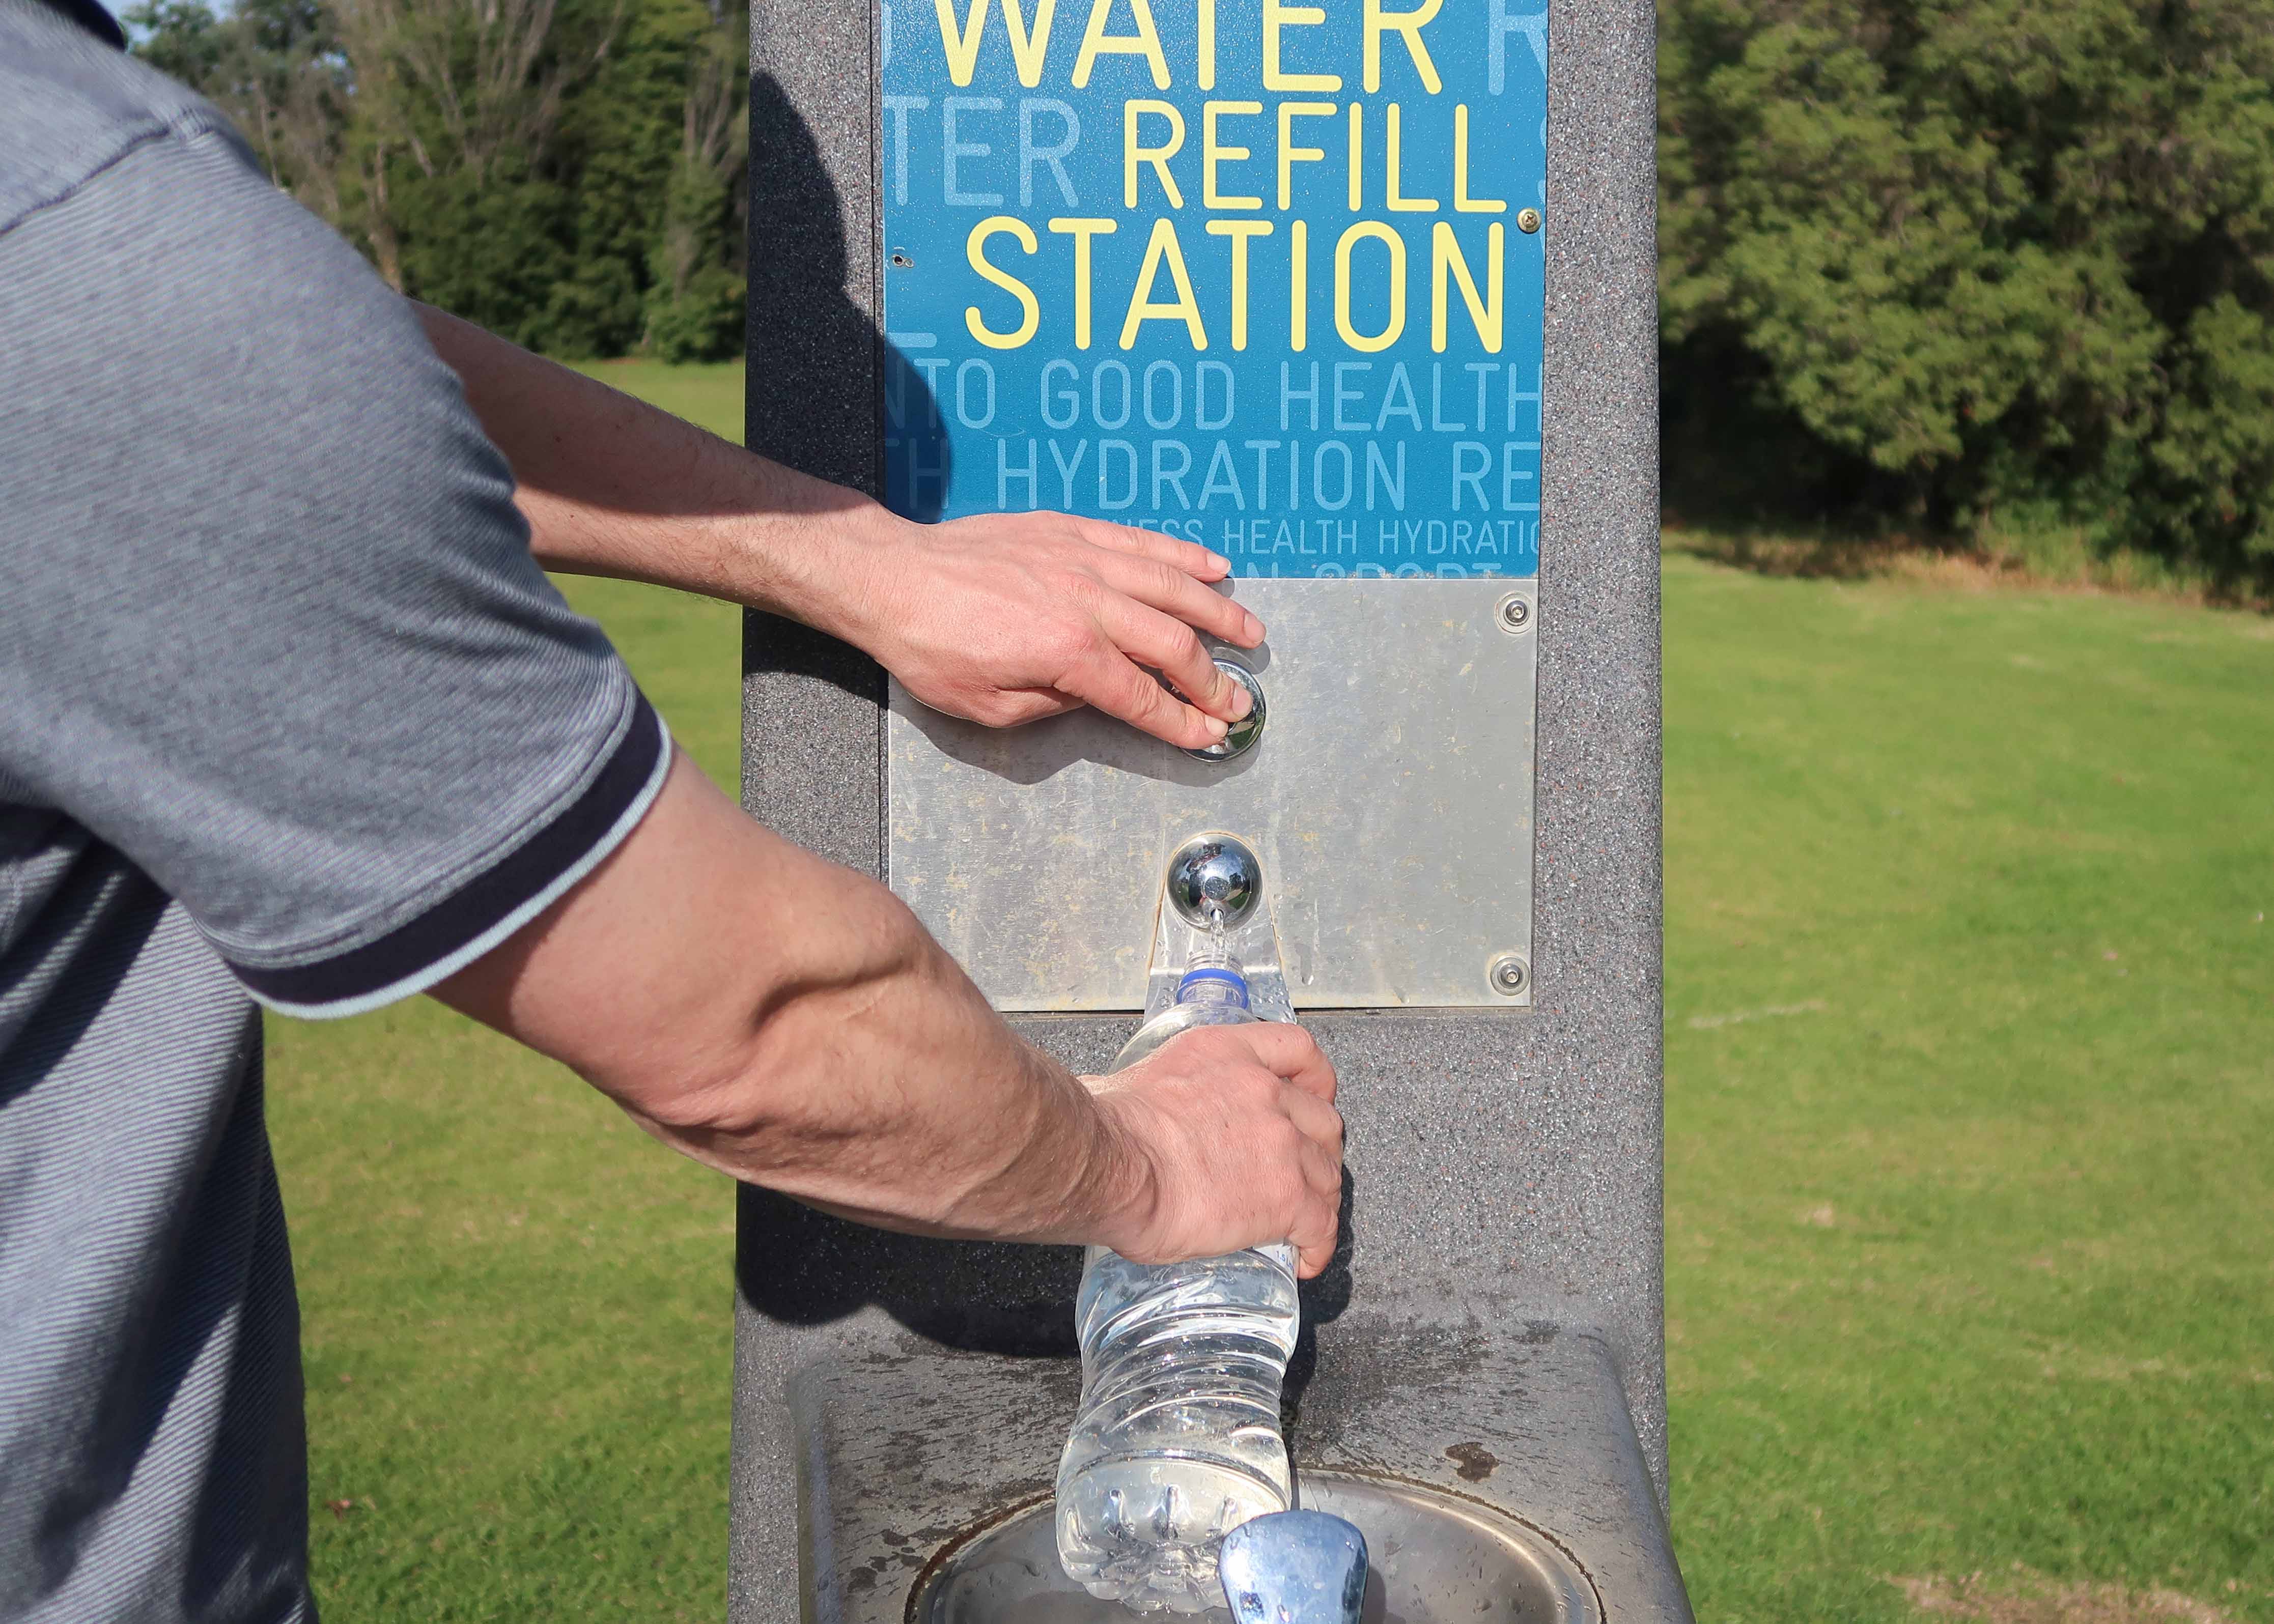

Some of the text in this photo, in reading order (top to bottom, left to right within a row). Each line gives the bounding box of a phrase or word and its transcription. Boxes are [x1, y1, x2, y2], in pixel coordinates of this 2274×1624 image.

[1123, 99, 1507, 213] REFILL
[964, 215, 1504, 354] STATION
[1041, 358, 1235, 431] GOOD
[1280, 361, 1542, 433] HEALTH
[997, 438, 1406, 511] HYDRATION
[1452, 441, 1540, 512] RE
[1224, 519, 1357, 554] HEALTH
[1275, 1250, 1286, 1262] 1.5
